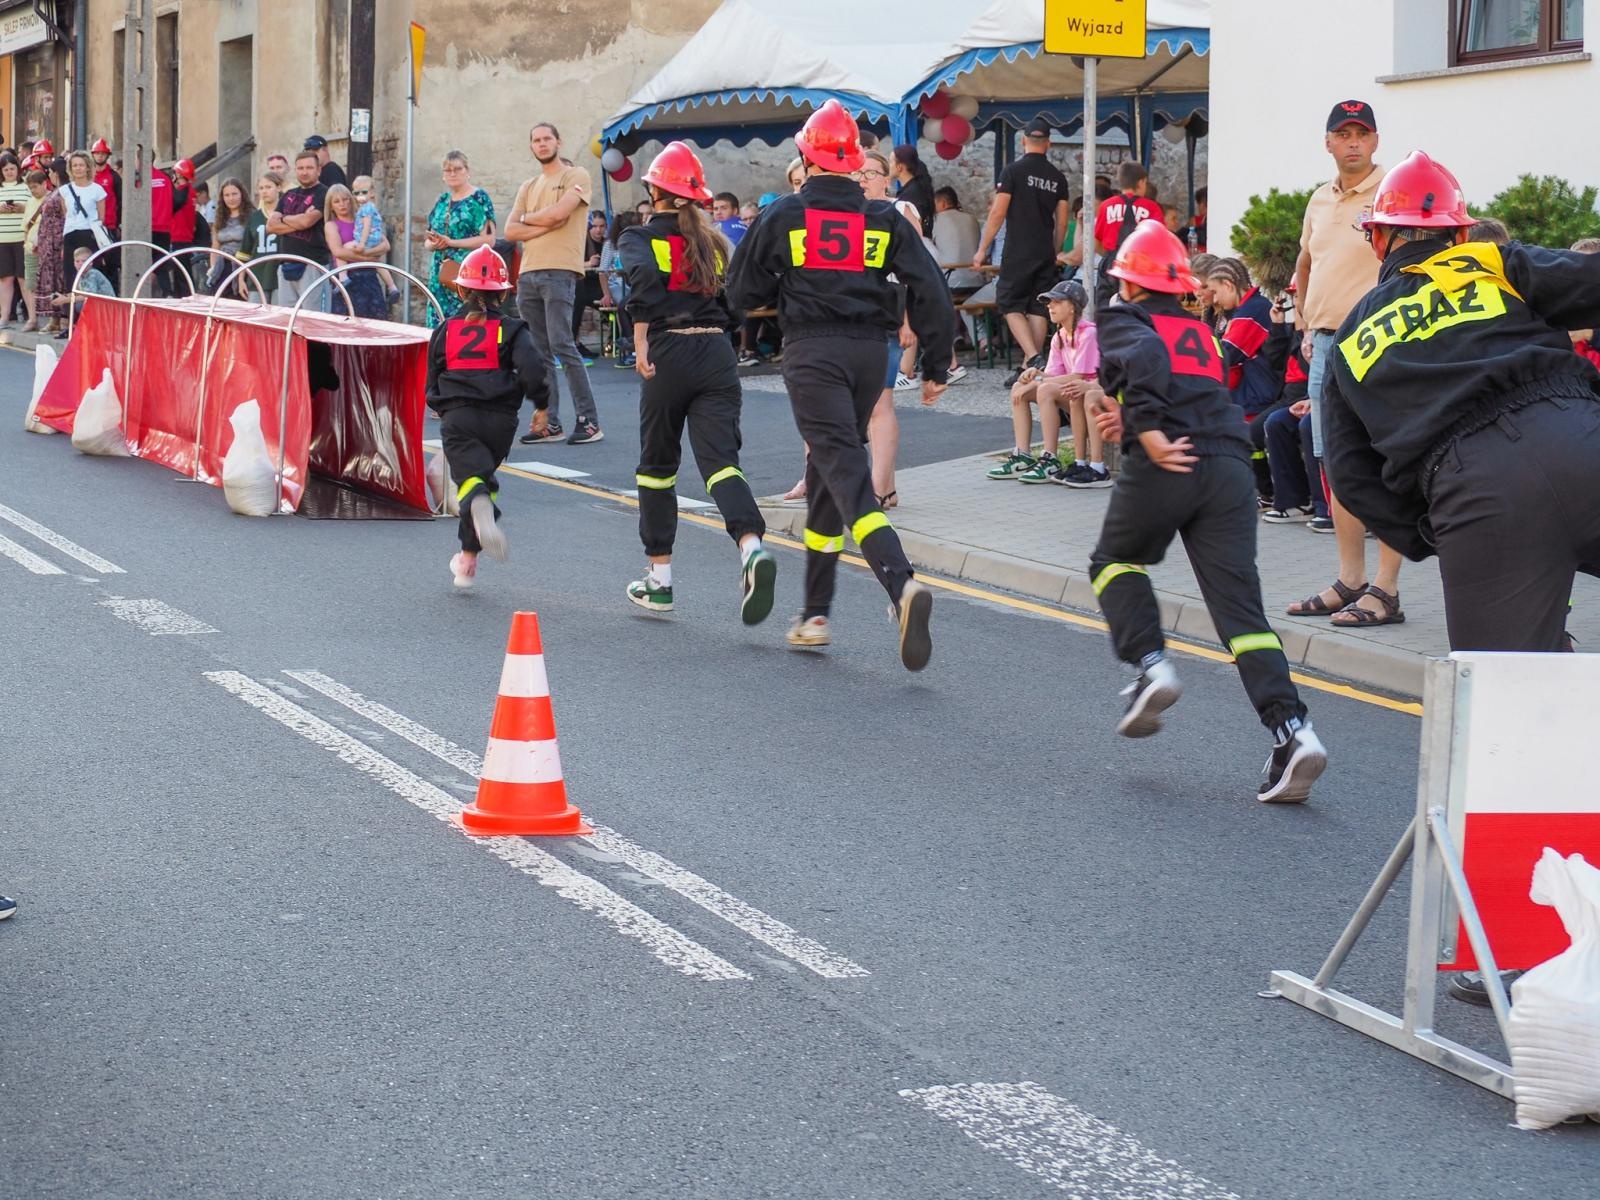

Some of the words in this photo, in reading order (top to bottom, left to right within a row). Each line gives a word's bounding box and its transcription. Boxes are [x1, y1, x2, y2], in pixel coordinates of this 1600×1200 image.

[19, 12, 41, 31] FIRMOW
[1067, 17, 1123, 37] Wyjazd
[256, 224, 278, 253] 12
[817, 219, 851, 262] 5
[458, 324, 488, 359] 2
[1175, 326, 1211, 368] 4
